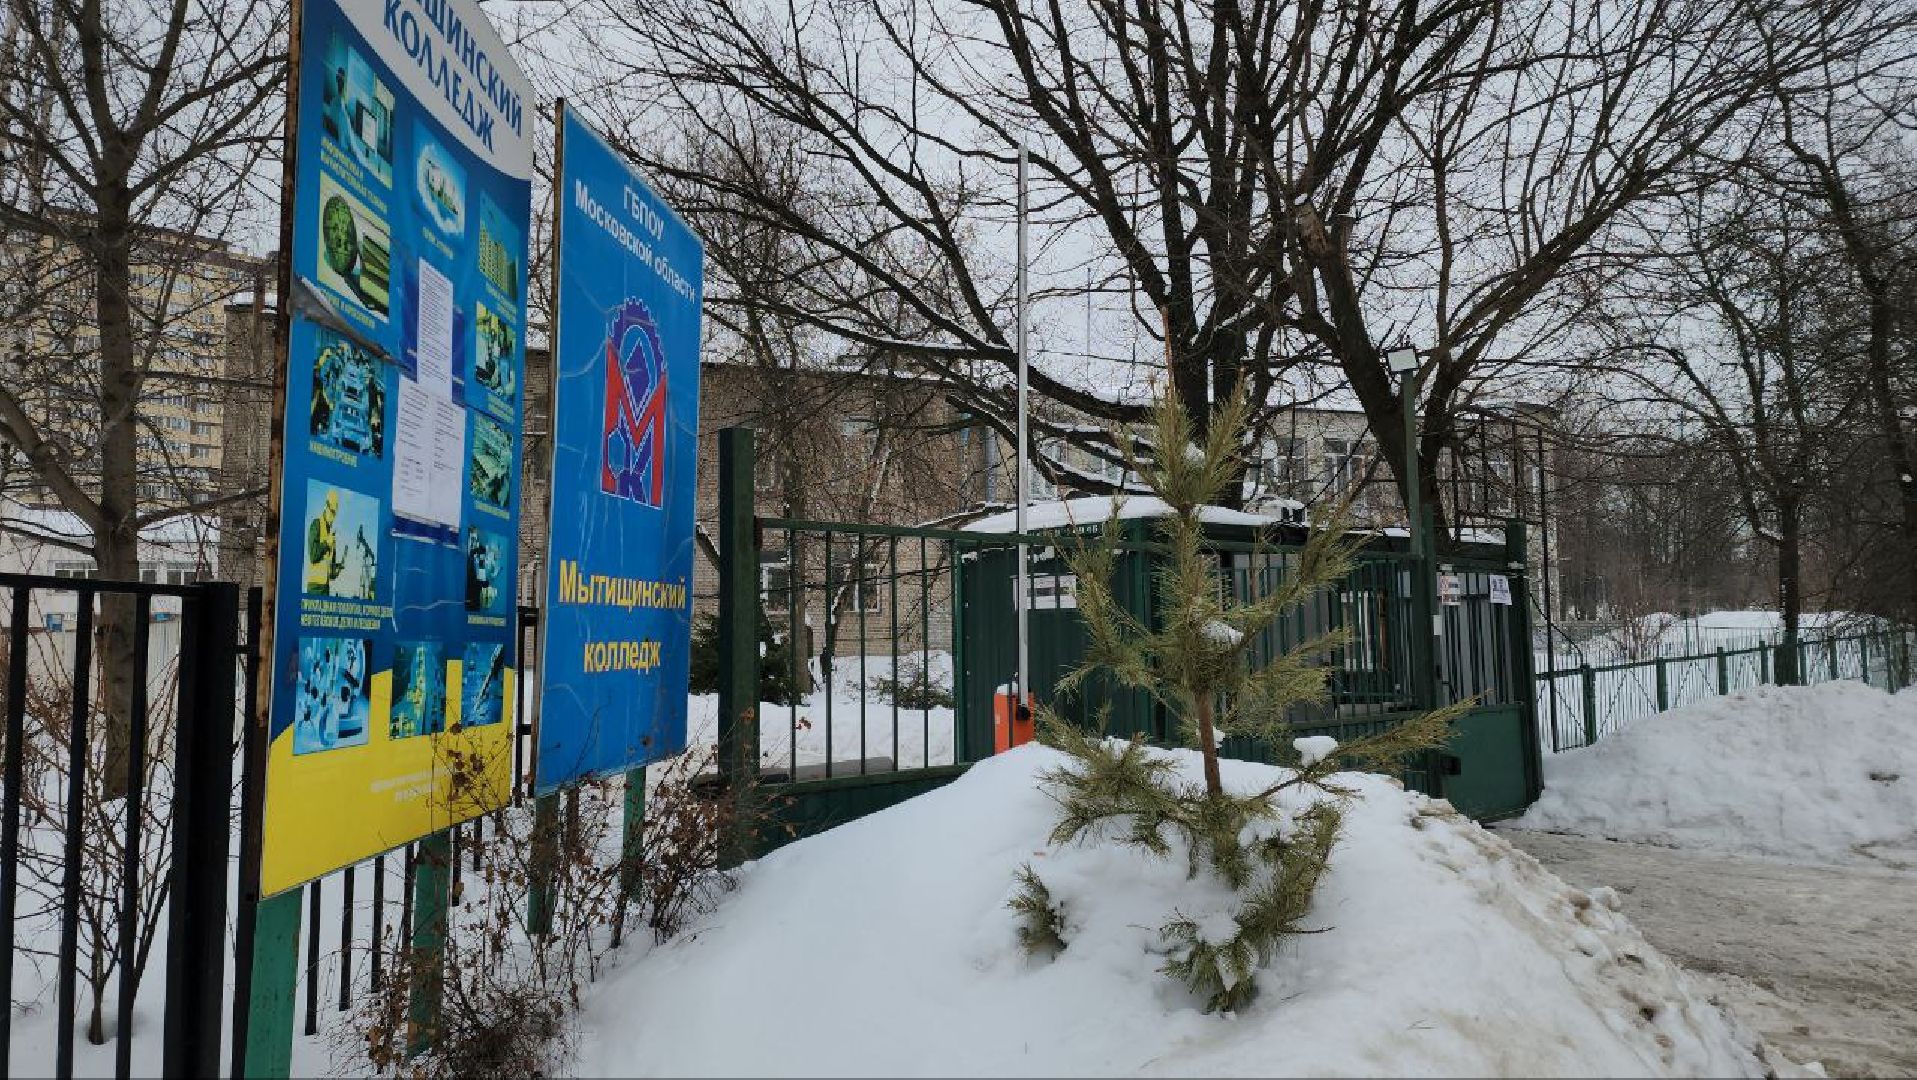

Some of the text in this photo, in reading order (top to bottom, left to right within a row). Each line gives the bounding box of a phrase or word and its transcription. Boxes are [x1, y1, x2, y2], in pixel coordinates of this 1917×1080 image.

[383, 0, 494, 154] КОЛЛЕДЖ
[416, 0, 522, 138] ЩИНСКИЙ
[575, 178, 695, 305] Московской области
[623, 184, 664, 241] ГБПОУ
[558, 558, 686, 613] Мытищинский
[583, 637, 661, 676] колледж
